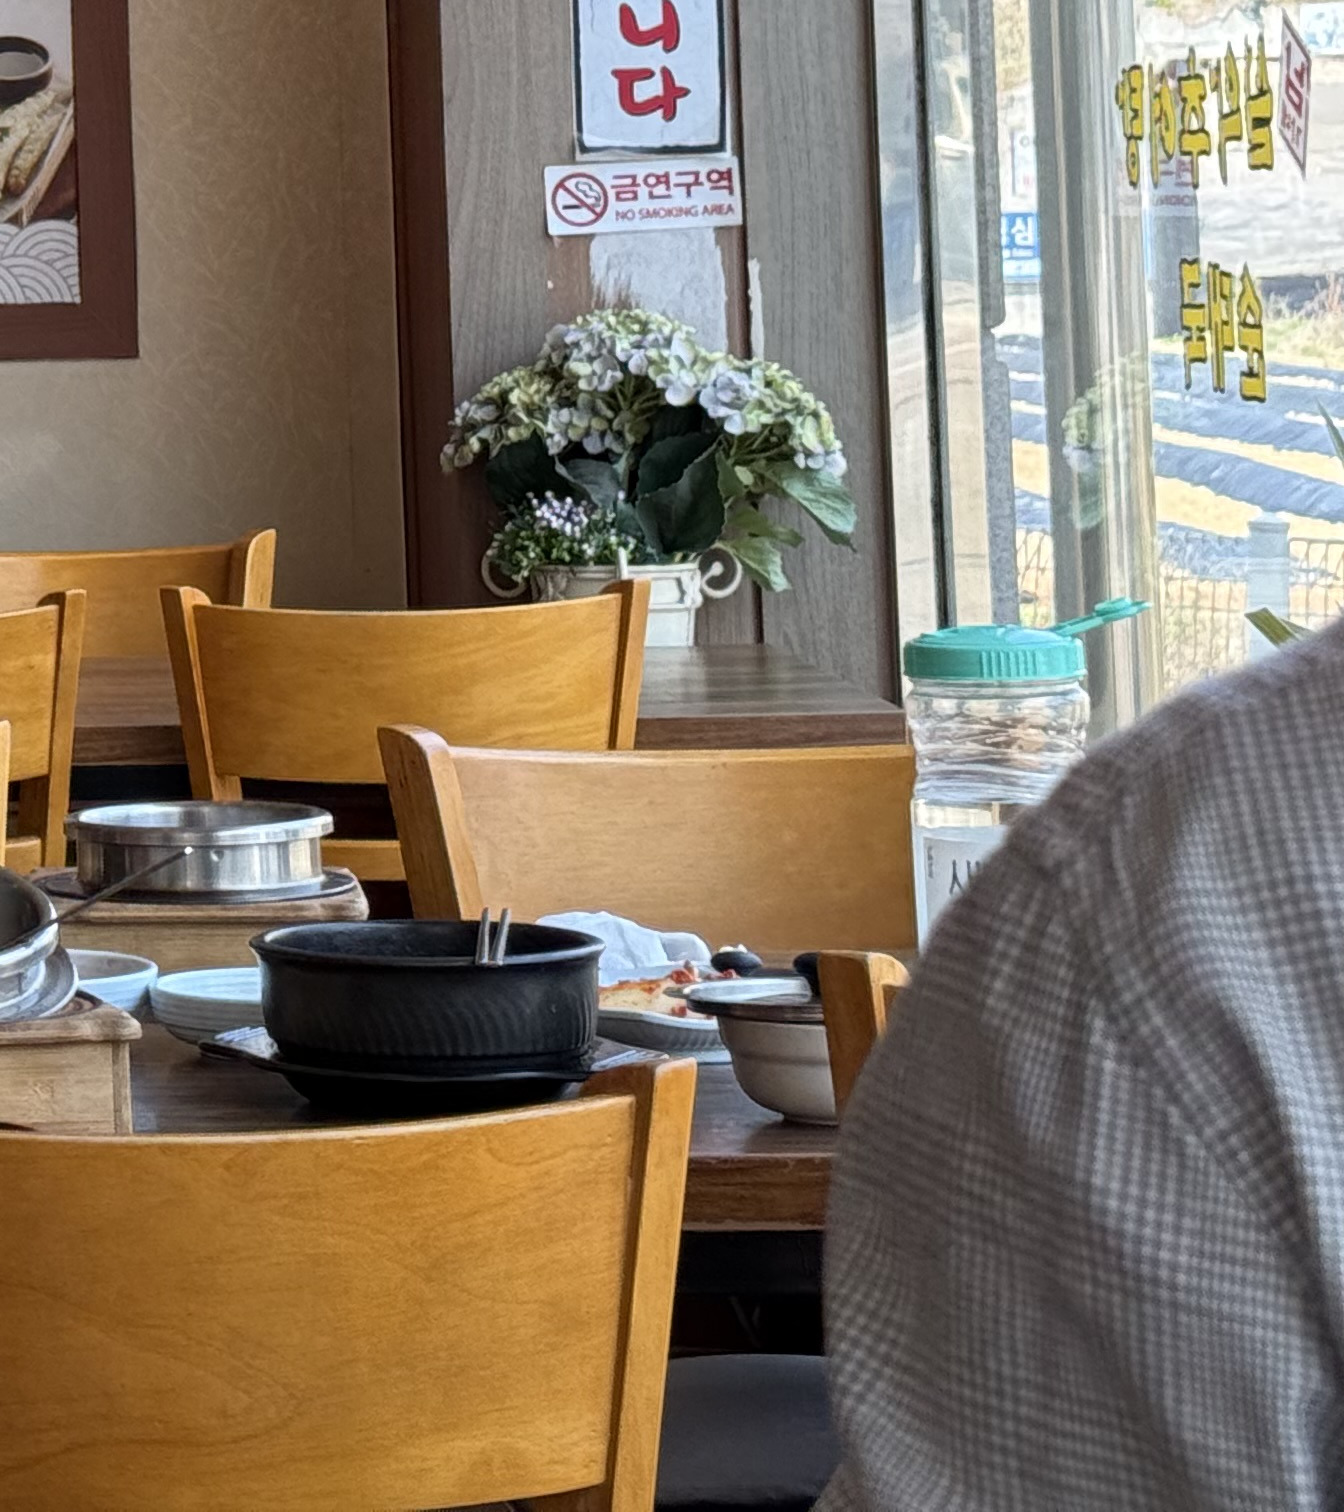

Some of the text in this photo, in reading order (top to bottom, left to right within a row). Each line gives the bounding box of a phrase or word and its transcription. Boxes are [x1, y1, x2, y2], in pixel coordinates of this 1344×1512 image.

[610, 166, 735, 203] 금연구역
[615, 202, 736, 222] NO SMOKING AREA
